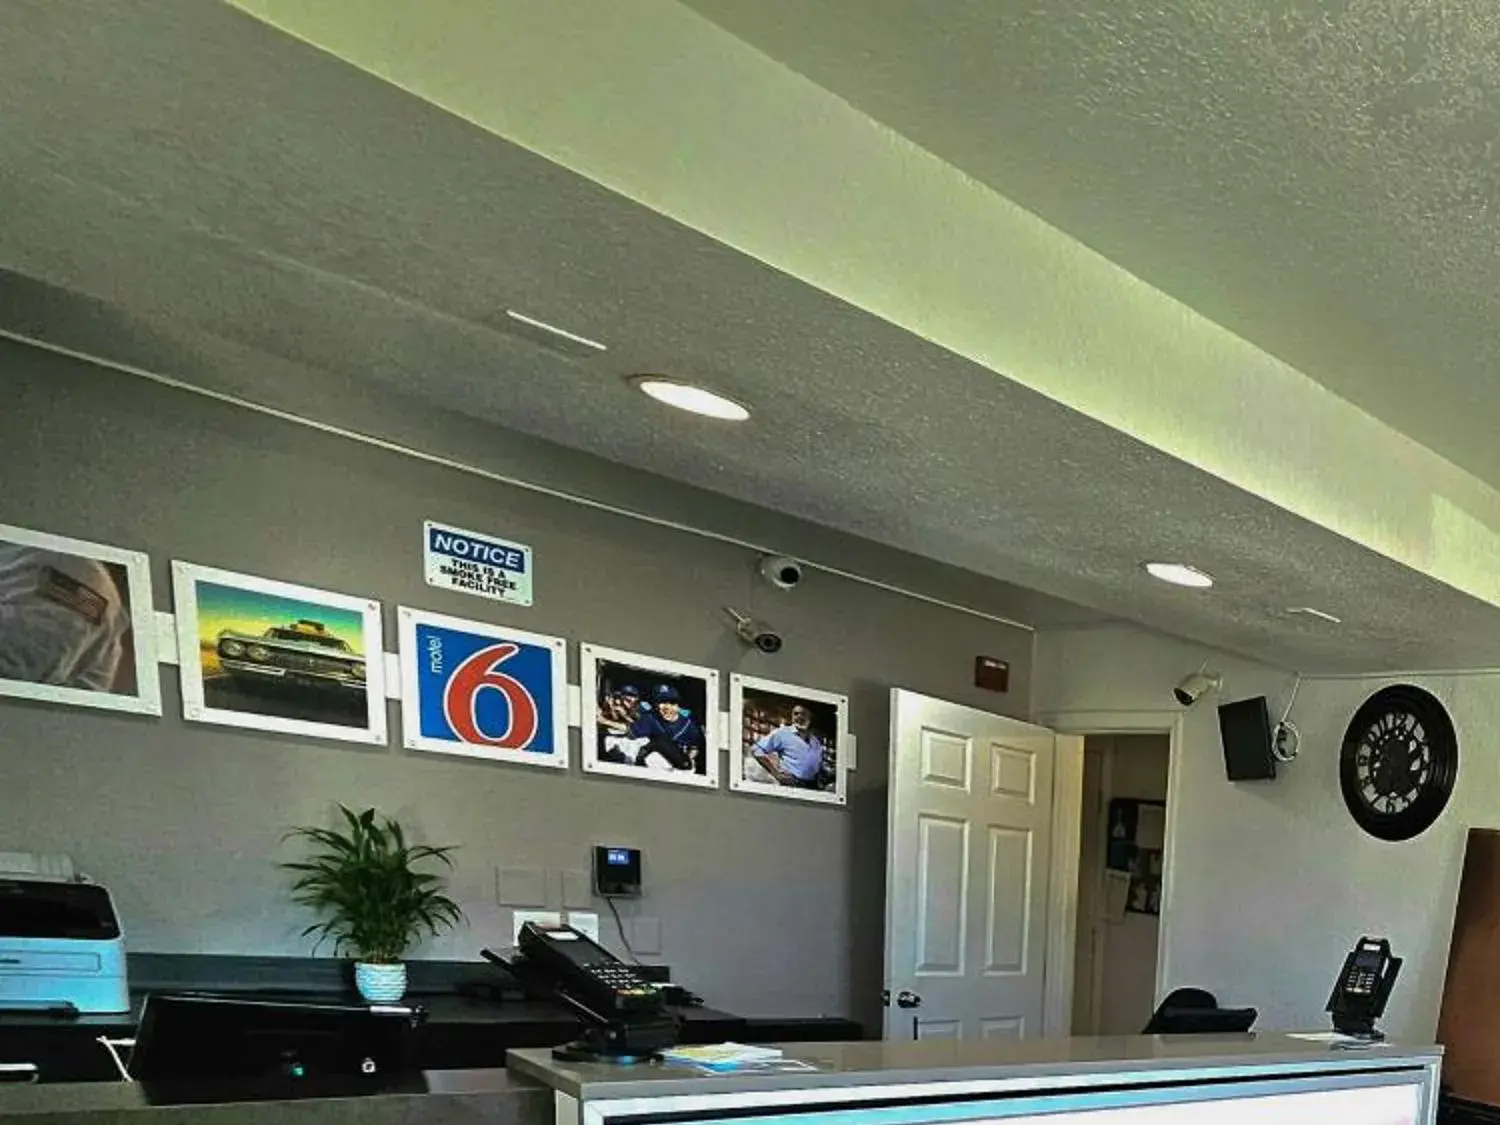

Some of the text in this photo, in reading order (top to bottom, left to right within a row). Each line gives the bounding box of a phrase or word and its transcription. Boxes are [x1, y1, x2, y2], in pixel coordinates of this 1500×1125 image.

[434, 533, 520, 569] NOTICE
[440, 565, 517, 590] SMOKE FREE
[451, 559, 505, 578] THIS IS A
[451, 577, 505, 597] FACILITY
[427, 635, 444, 674] motel
[443, 643, 539, 751] 6
